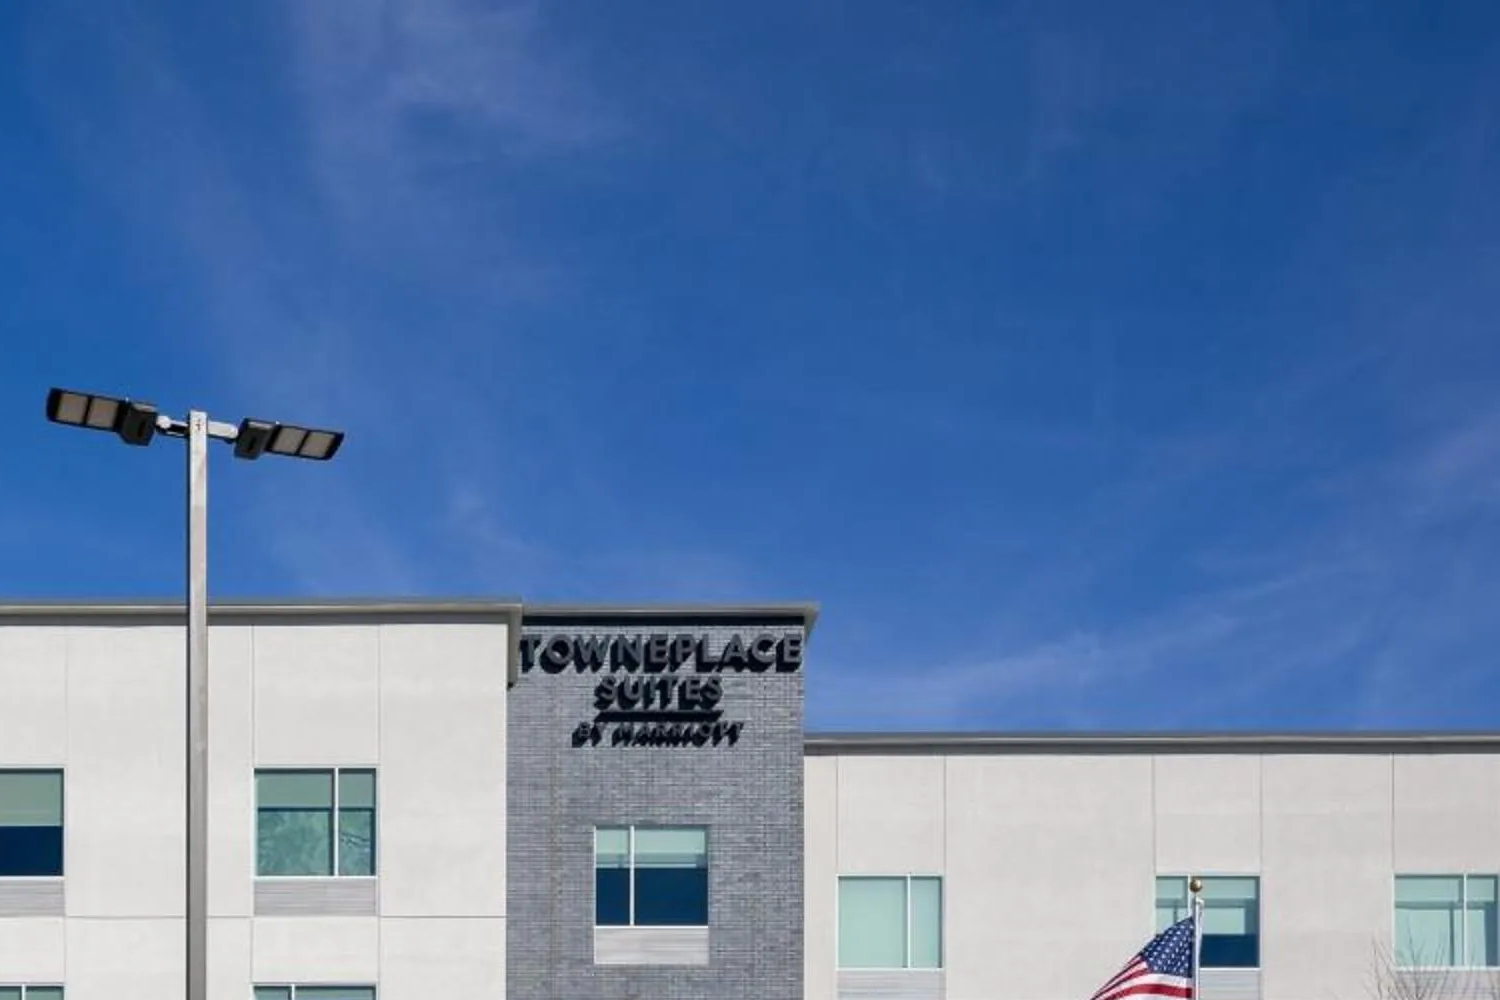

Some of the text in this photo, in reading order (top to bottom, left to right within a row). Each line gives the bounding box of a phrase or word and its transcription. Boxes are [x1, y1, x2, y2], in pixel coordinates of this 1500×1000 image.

[520, 634, 801, 670] TOWNEPLACE
[596, 675, 723, 705] SUITES
[575, 722, 744, 743] BY MARRIOTT
